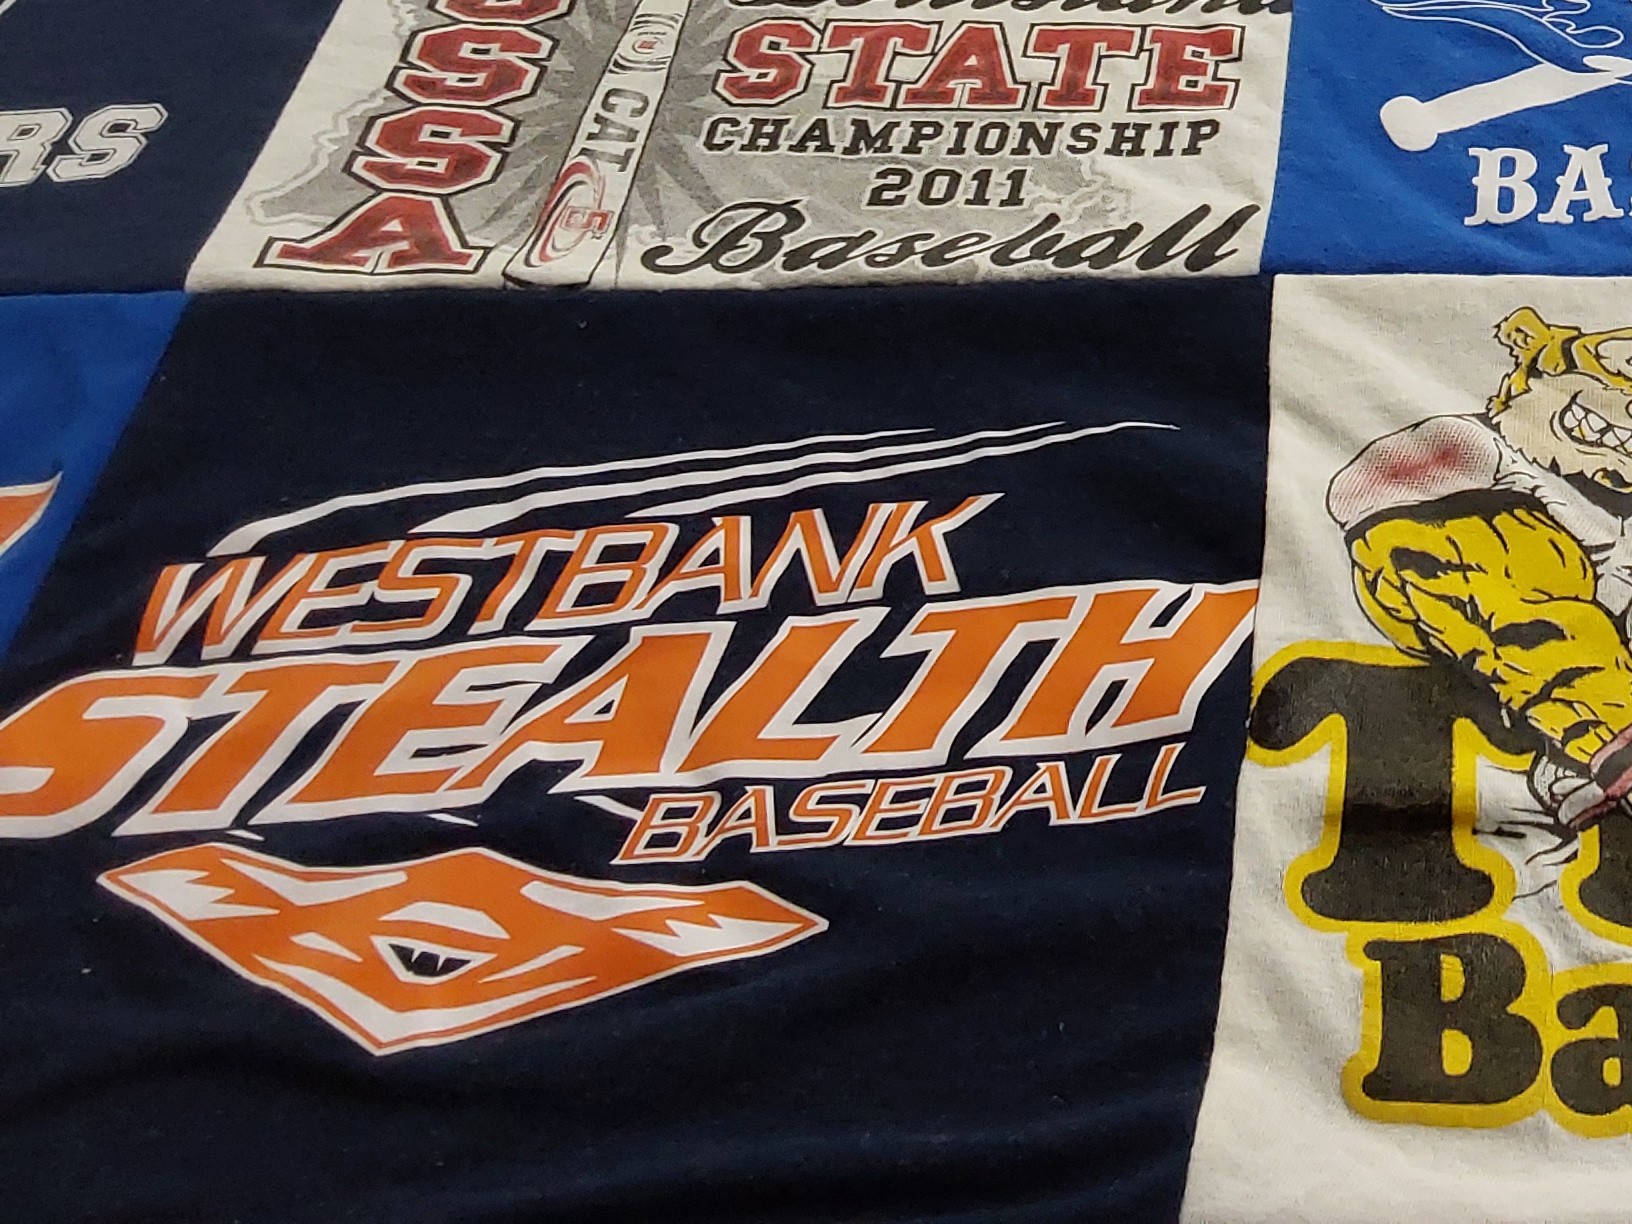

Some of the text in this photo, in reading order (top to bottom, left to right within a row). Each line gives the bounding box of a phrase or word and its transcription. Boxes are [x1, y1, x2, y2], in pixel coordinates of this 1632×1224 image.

[711, 16, 1248, 114] STATE
[577, 86, 651, 175] CAT
[702, 116, 1222, 160] CHAMPIONSHIP
[866, 167, 1030, 210] 2011
[640, 200, 1264, 278] Baseball
[134, 492, 1006, 666] WESTBANK
[0, 579, 1262, 840] STEALTH
[611, 744, 1208, 866] BASEBALL
